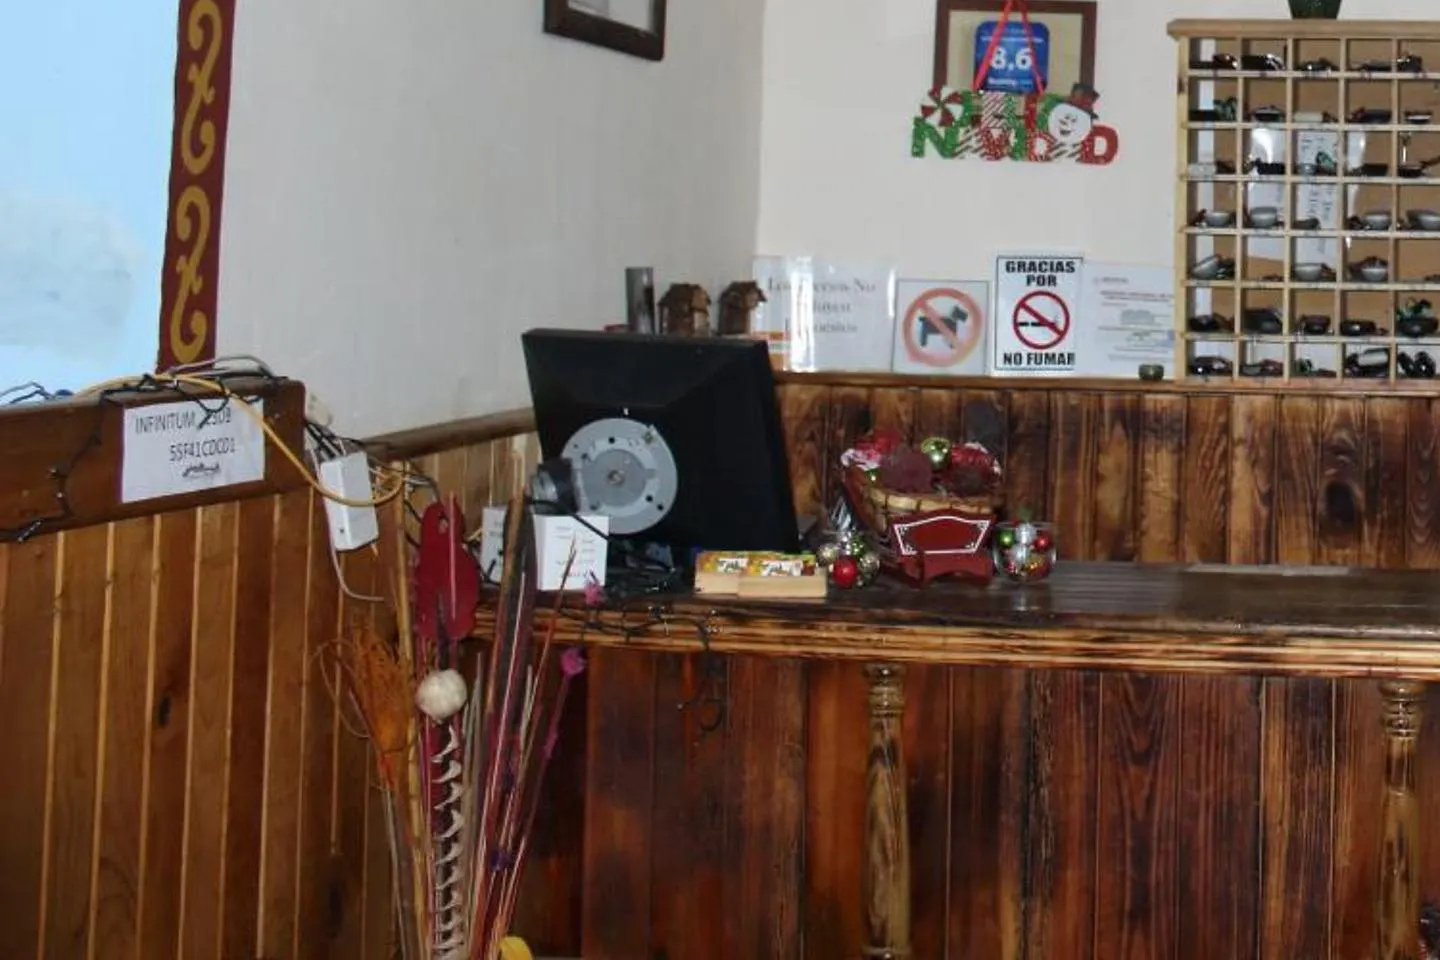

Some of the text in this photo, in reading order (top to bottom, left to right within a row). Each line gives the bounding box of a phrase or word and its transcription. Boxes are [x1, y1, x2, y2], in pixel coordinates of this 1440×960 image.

[1005, 260, 1075, 273] GRACIAS
[1026, 275, 1057, 287] POR
[1003, 352, 1076, 366] NO FUMAR
[135, 411, 197, 434] INFINITUM
